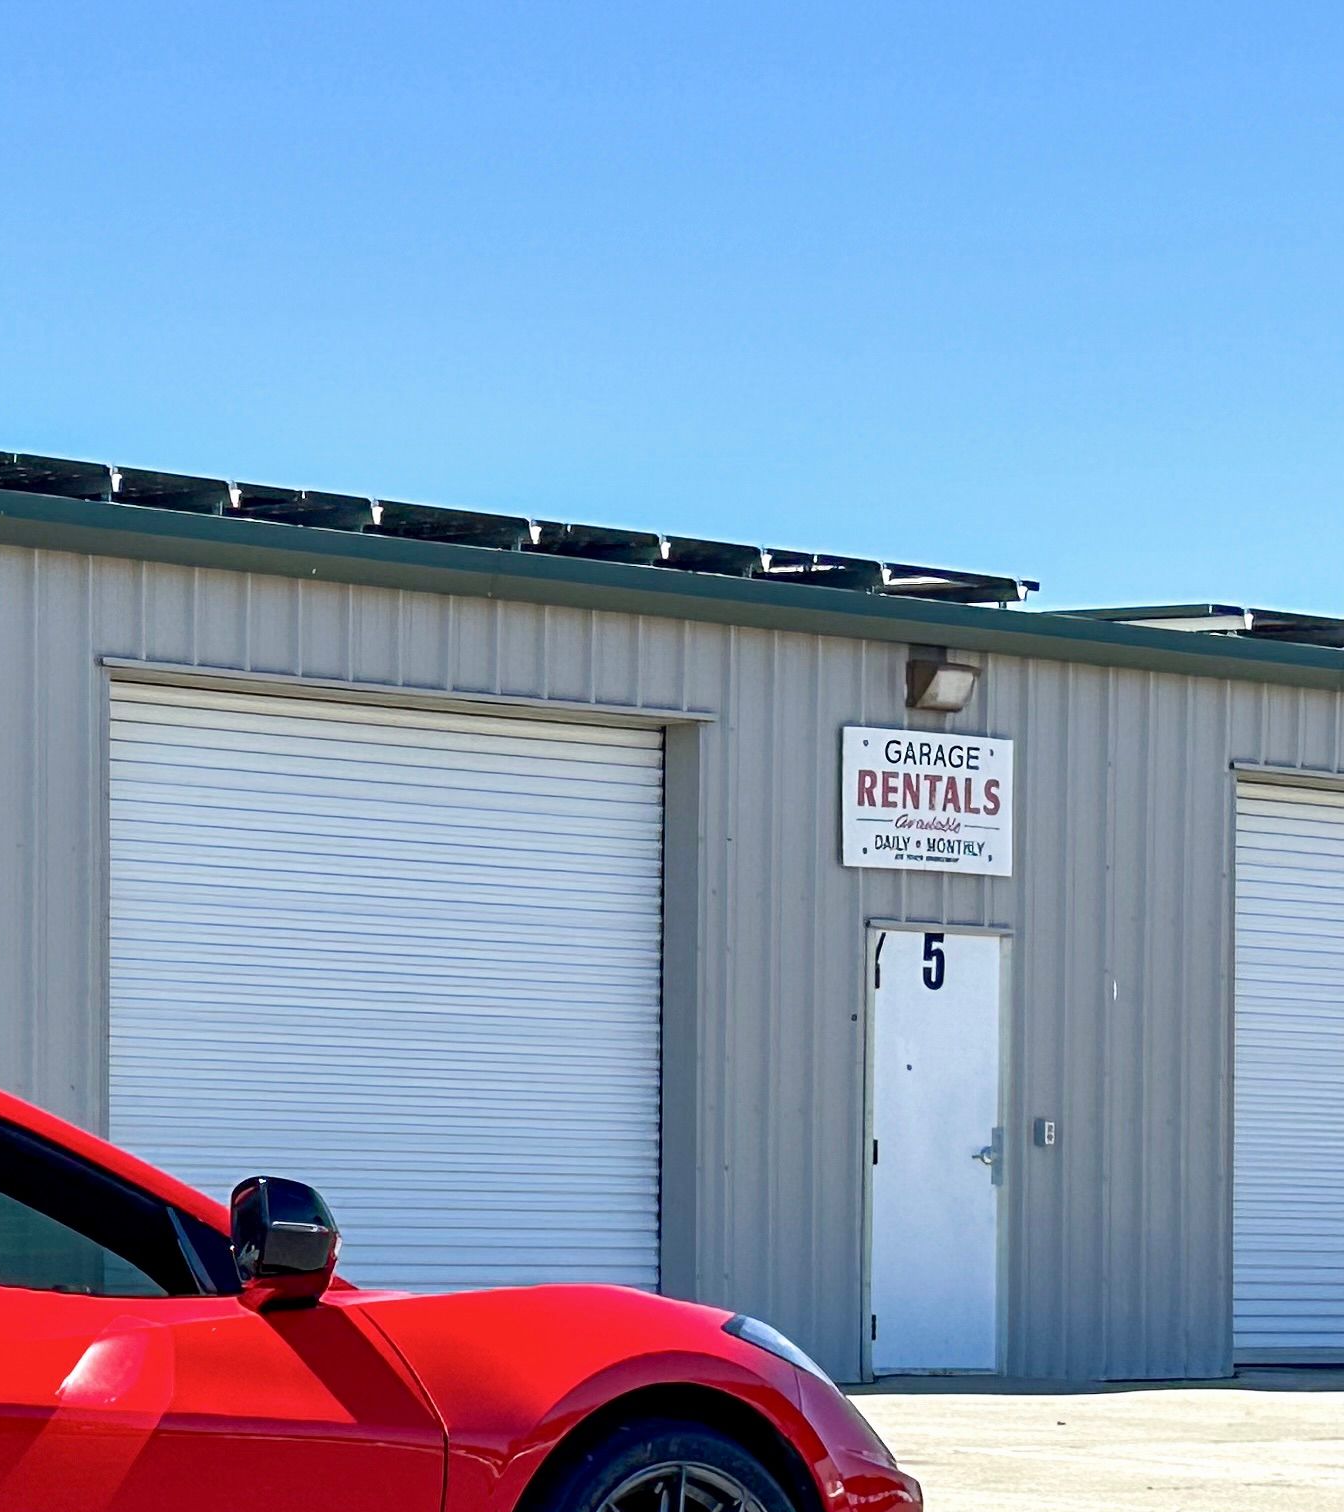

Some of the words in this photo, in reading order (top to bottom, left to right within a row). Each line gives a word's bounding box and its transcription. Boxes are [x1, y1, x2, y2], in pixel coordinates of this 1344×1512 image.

[884, 739, 981, 770] GARAGE
[856, 769, 1001, 816] RENTALS
[874, 834, 911, 852] DAILY
[922, 932, 945, 991] 5
